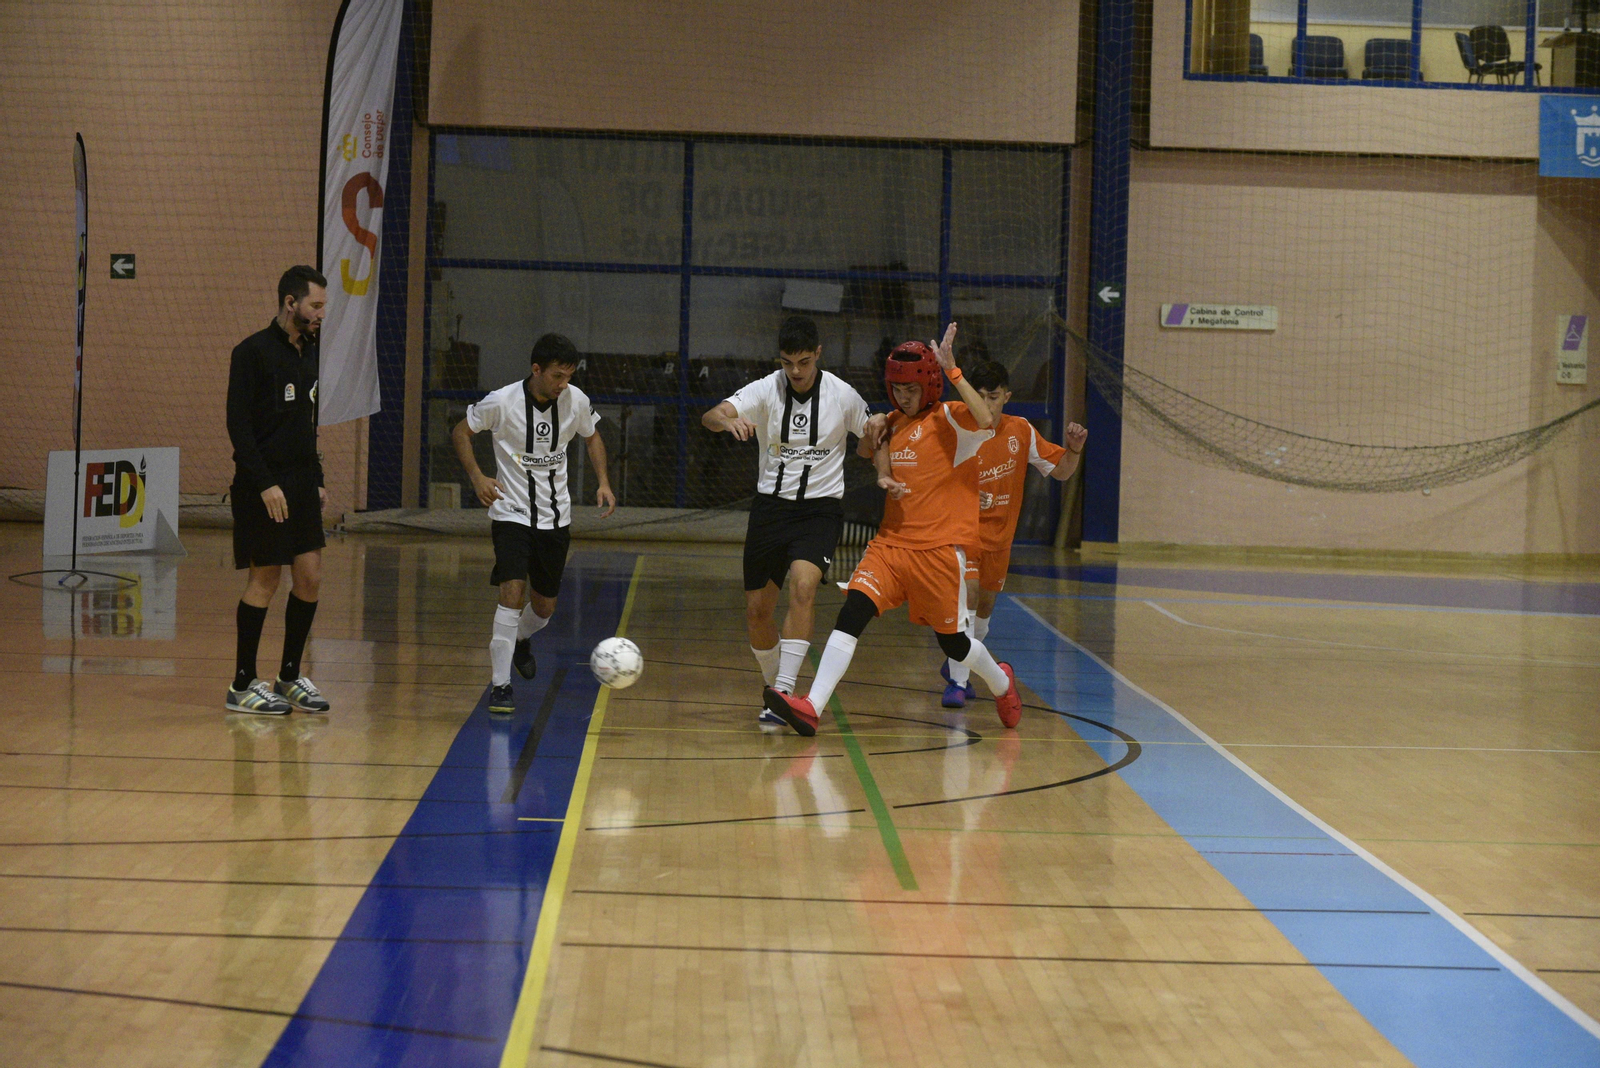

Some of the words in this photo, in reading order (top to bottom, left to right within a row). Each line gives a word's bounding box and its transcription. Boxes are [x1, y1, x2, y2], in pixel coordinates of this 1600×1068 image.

[362, 113, 374, 158] Consejo
[1190, 307, 1217, 315] Cabina
[1220, 308, 1231, 316] de
[1234, 308, 1264, 317] Control
[576, 359, 587, 371] A
[664, 362, 674, 374] B
[698, 366, 709, 378] A
[780, 445, 798, 456] Gran
[799, 447, 830, 456] Canaria
[522, 455, 543, 464] Gran
